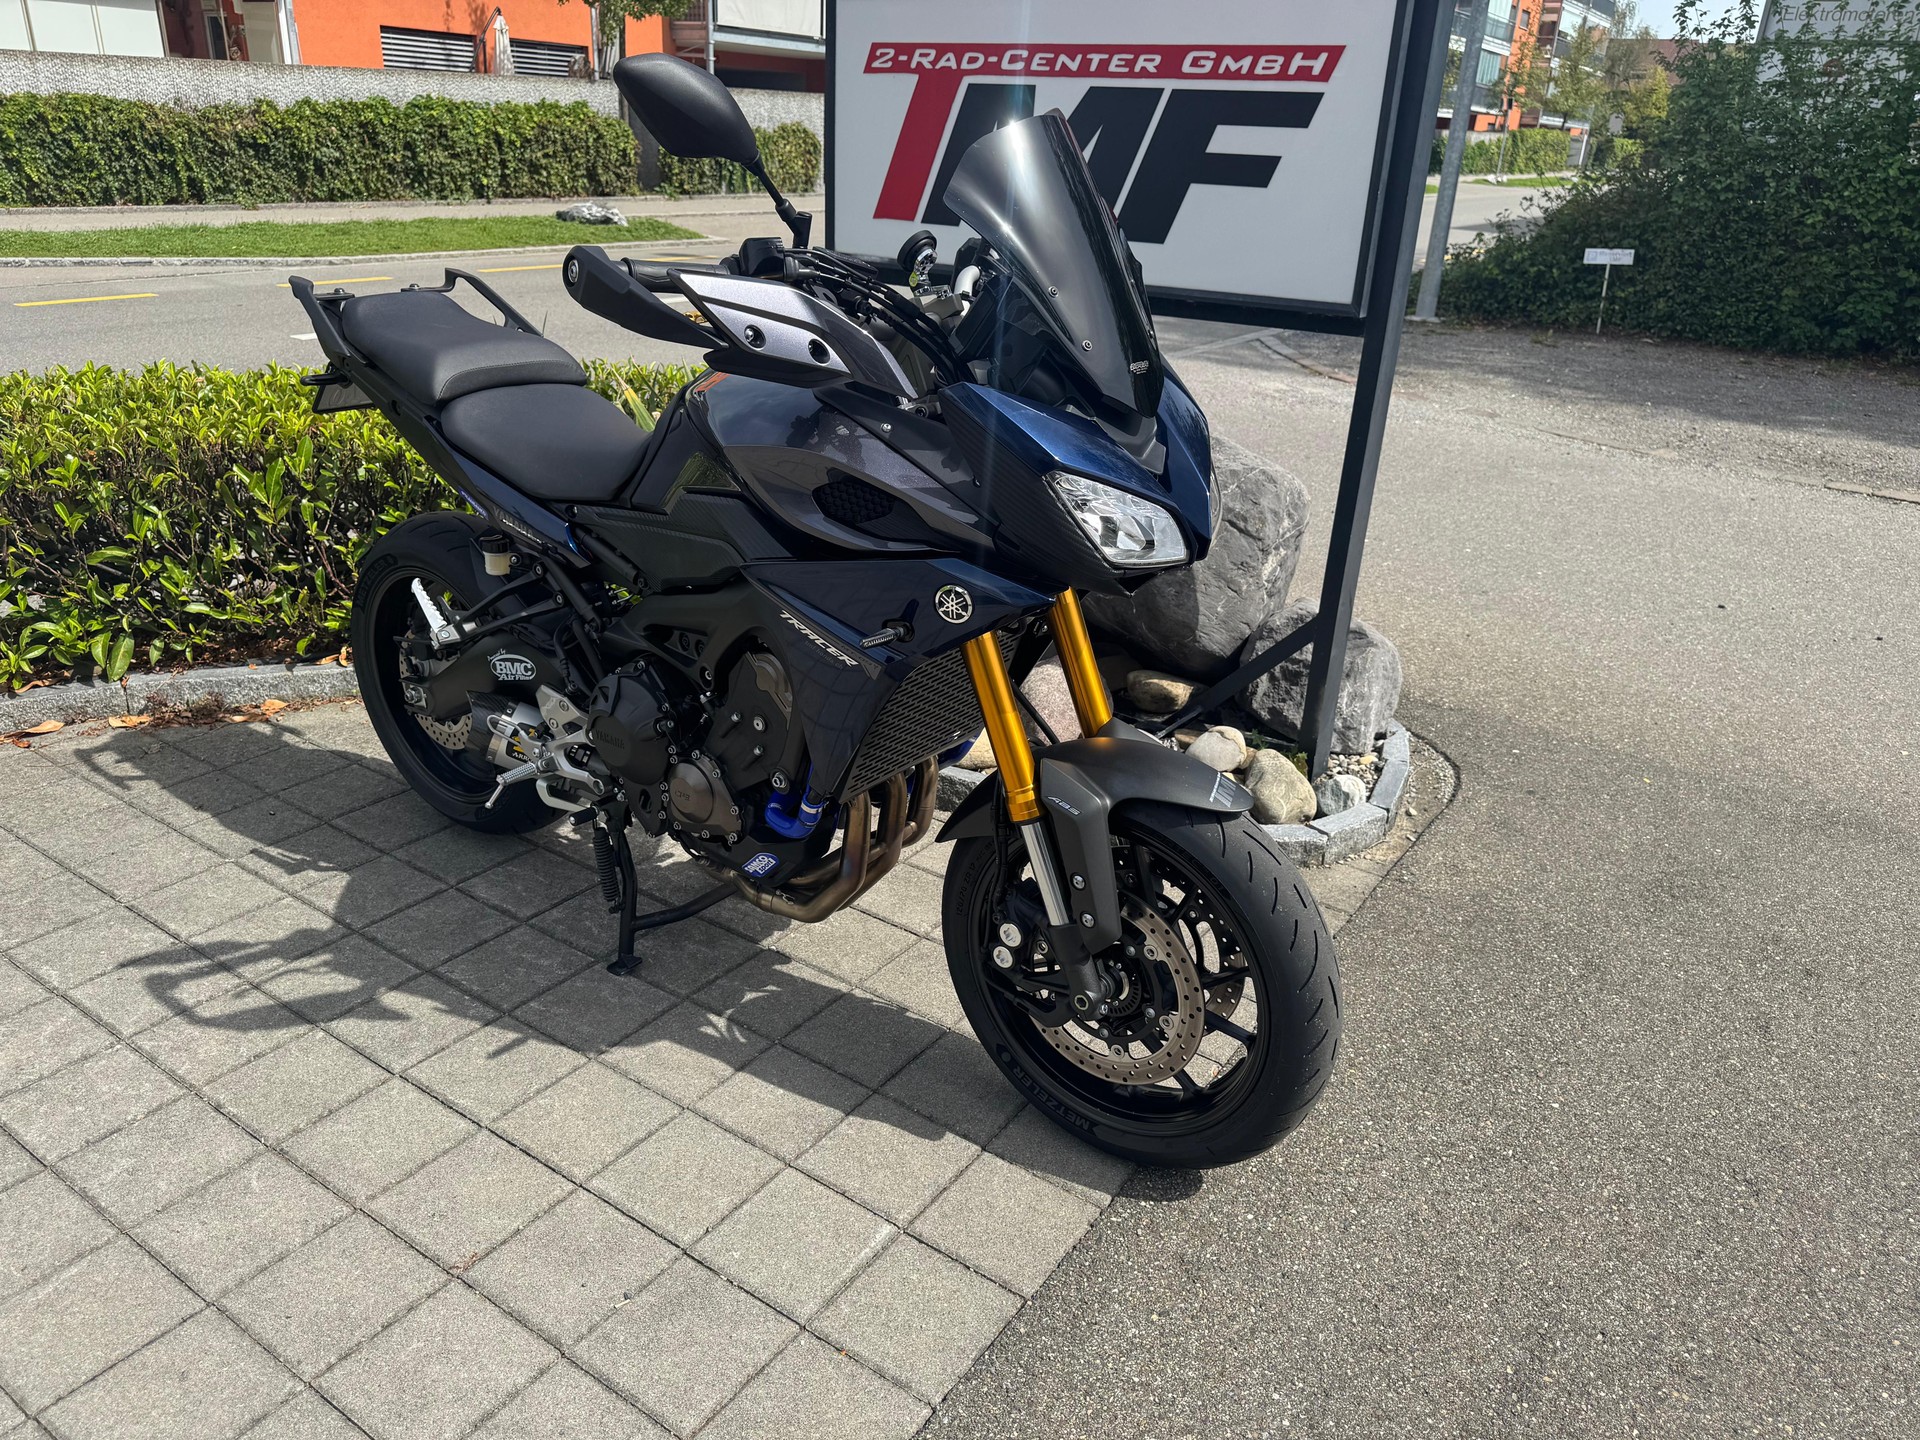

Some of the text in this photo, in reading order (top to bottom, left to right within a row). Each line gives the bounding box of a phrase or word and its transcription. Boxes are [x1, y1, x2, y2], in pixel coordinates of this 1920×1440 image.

[779, 609, 859, 668] TRACER
[494, 660, 532, 676] BMC
[498, 673, 515, 681] Air
[595, 728, 625, 750] YAMAHA
[1047, 796, 1080, 815] ABS
[1013, 1066, 1090, 1130] METZELER
